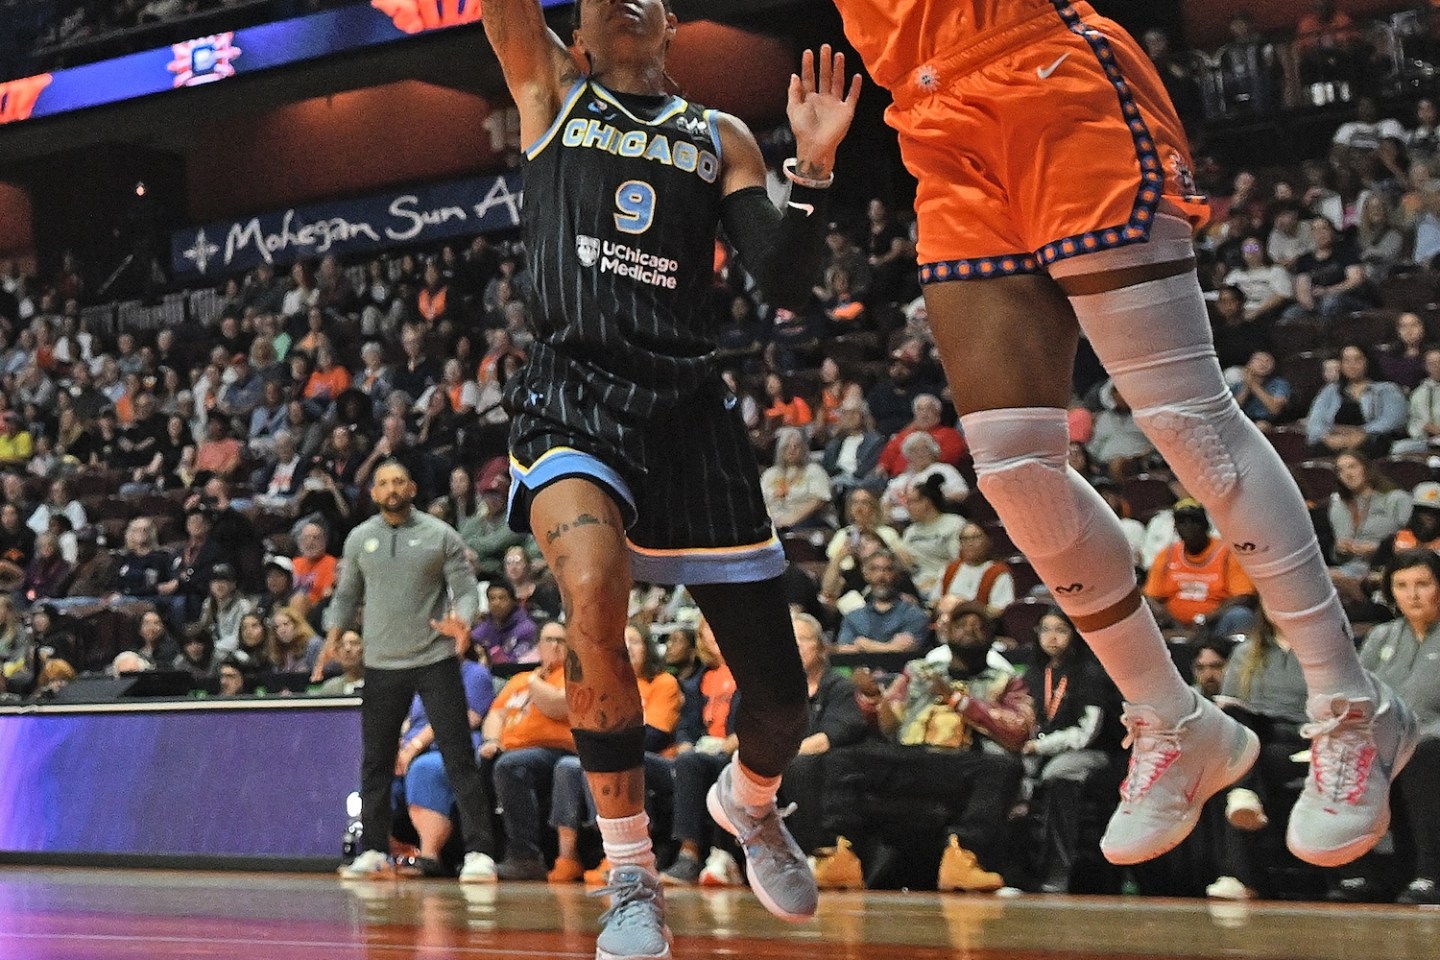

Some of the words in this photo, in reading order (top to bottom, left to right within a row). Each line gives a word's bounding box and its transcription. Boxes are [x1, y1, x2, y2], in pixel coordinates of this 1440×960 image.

[561, 117, 719, 184] CHICAGO
[224, 208, 381, 265] Mohegan
[384, 194, 467, 240] Sun
[613, 179, 657, 235] 9
[600, 257, 678, 290] Medicine
[602, 240, 679, 272] UChicago
